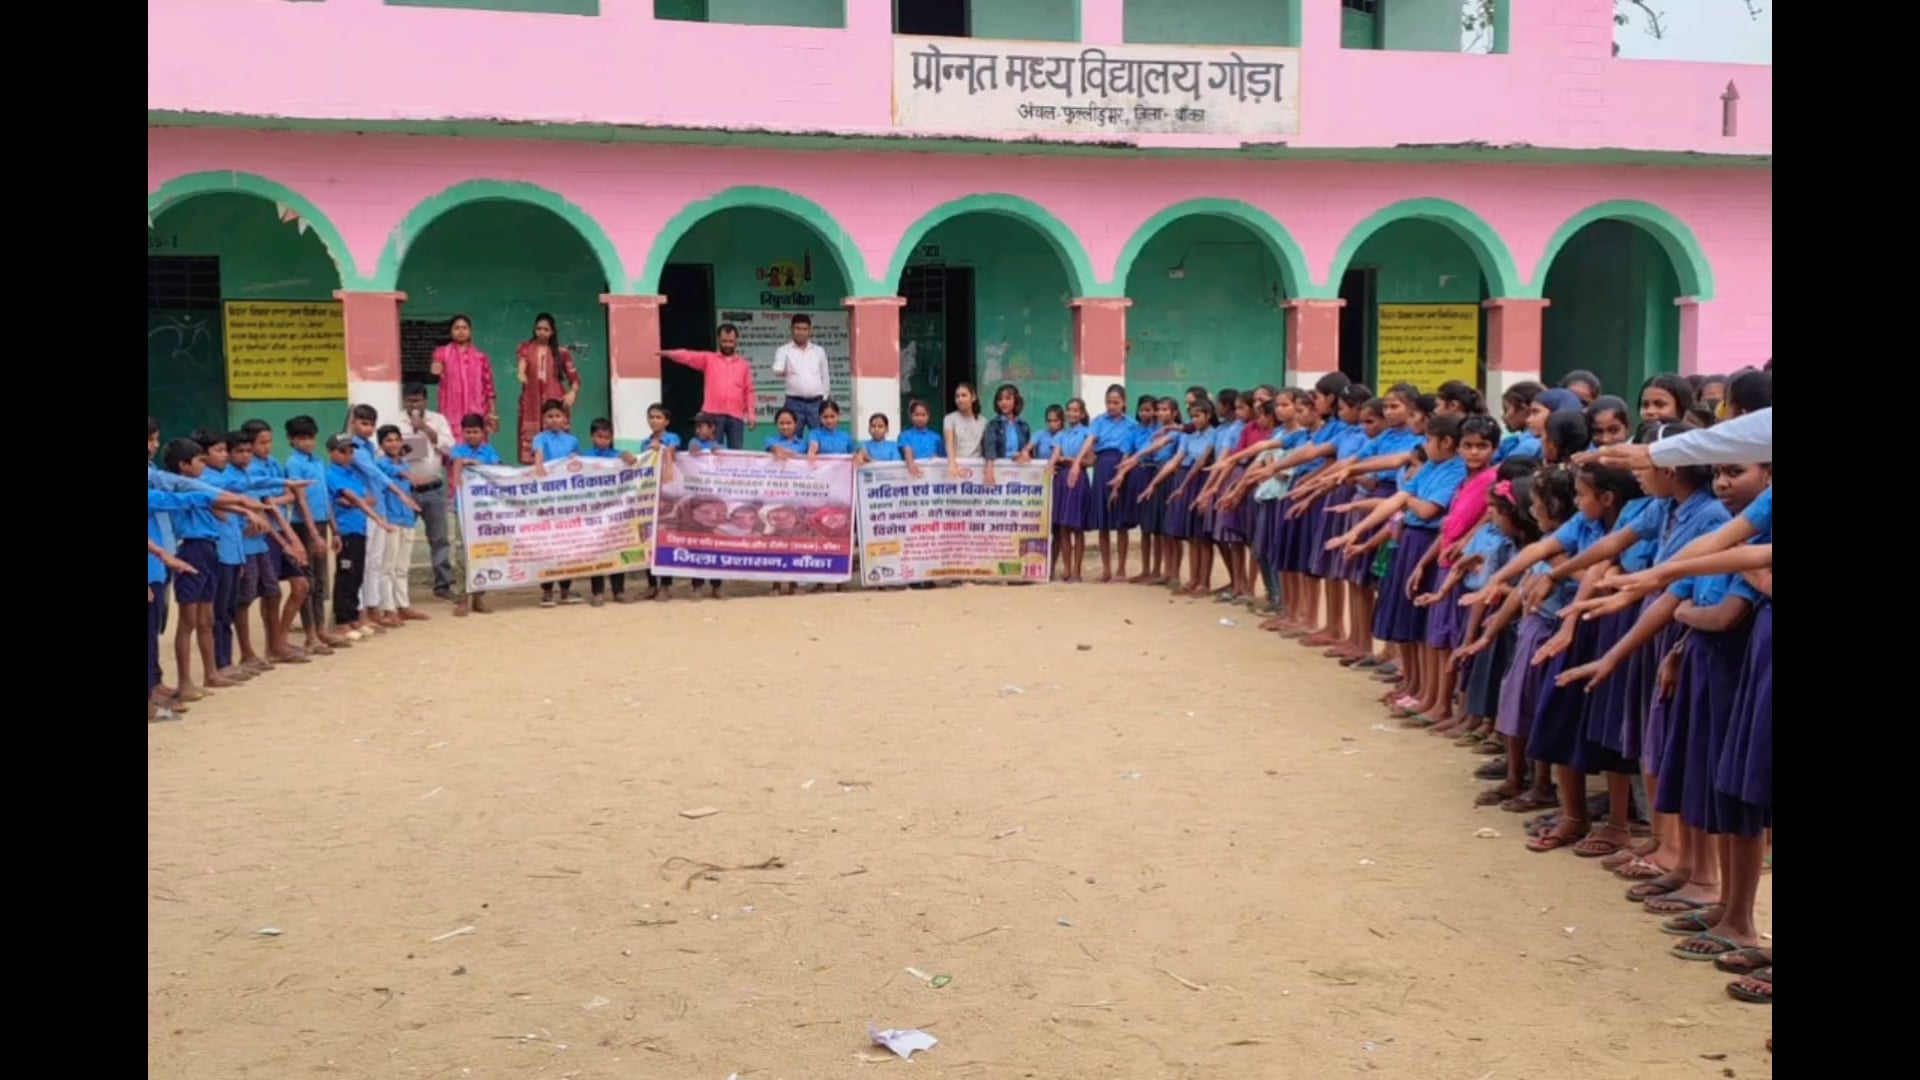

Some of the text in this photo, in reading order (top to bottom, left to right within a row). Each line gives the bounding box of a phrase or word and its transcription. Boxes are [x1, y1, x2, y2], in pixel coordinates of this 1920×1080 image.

[911, 44, 1284, 102] प्रोन्नत मध्य विद्यालय गोड़ा
[570, 472, 617, 489] विकास
[867, 484, 909, 499] महिला
[1005, 481, 1044, 496] निगम
[672, 547, 717, 564] जिला
[720, 554, 788, 569] प्रशासन,
